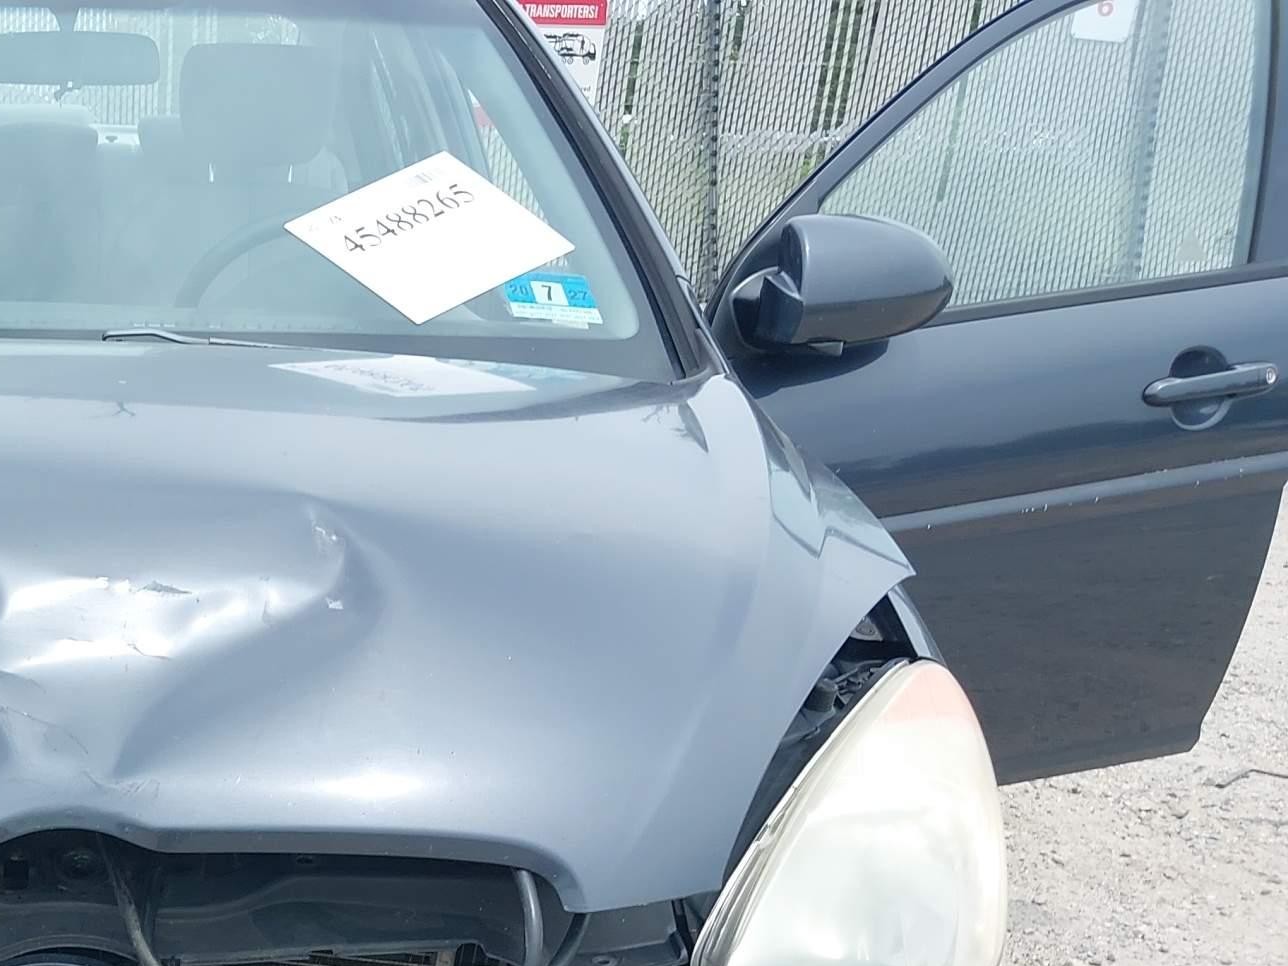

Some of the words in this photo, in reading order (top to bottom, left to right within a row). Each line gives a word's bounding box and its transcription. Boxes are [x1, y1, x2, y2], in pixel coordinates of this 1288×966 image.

[525, 3, 599, 19] TRANSPORTERS!
[344, 183, 475, 252] 45488265
[541, 284, 552, 301] 7
